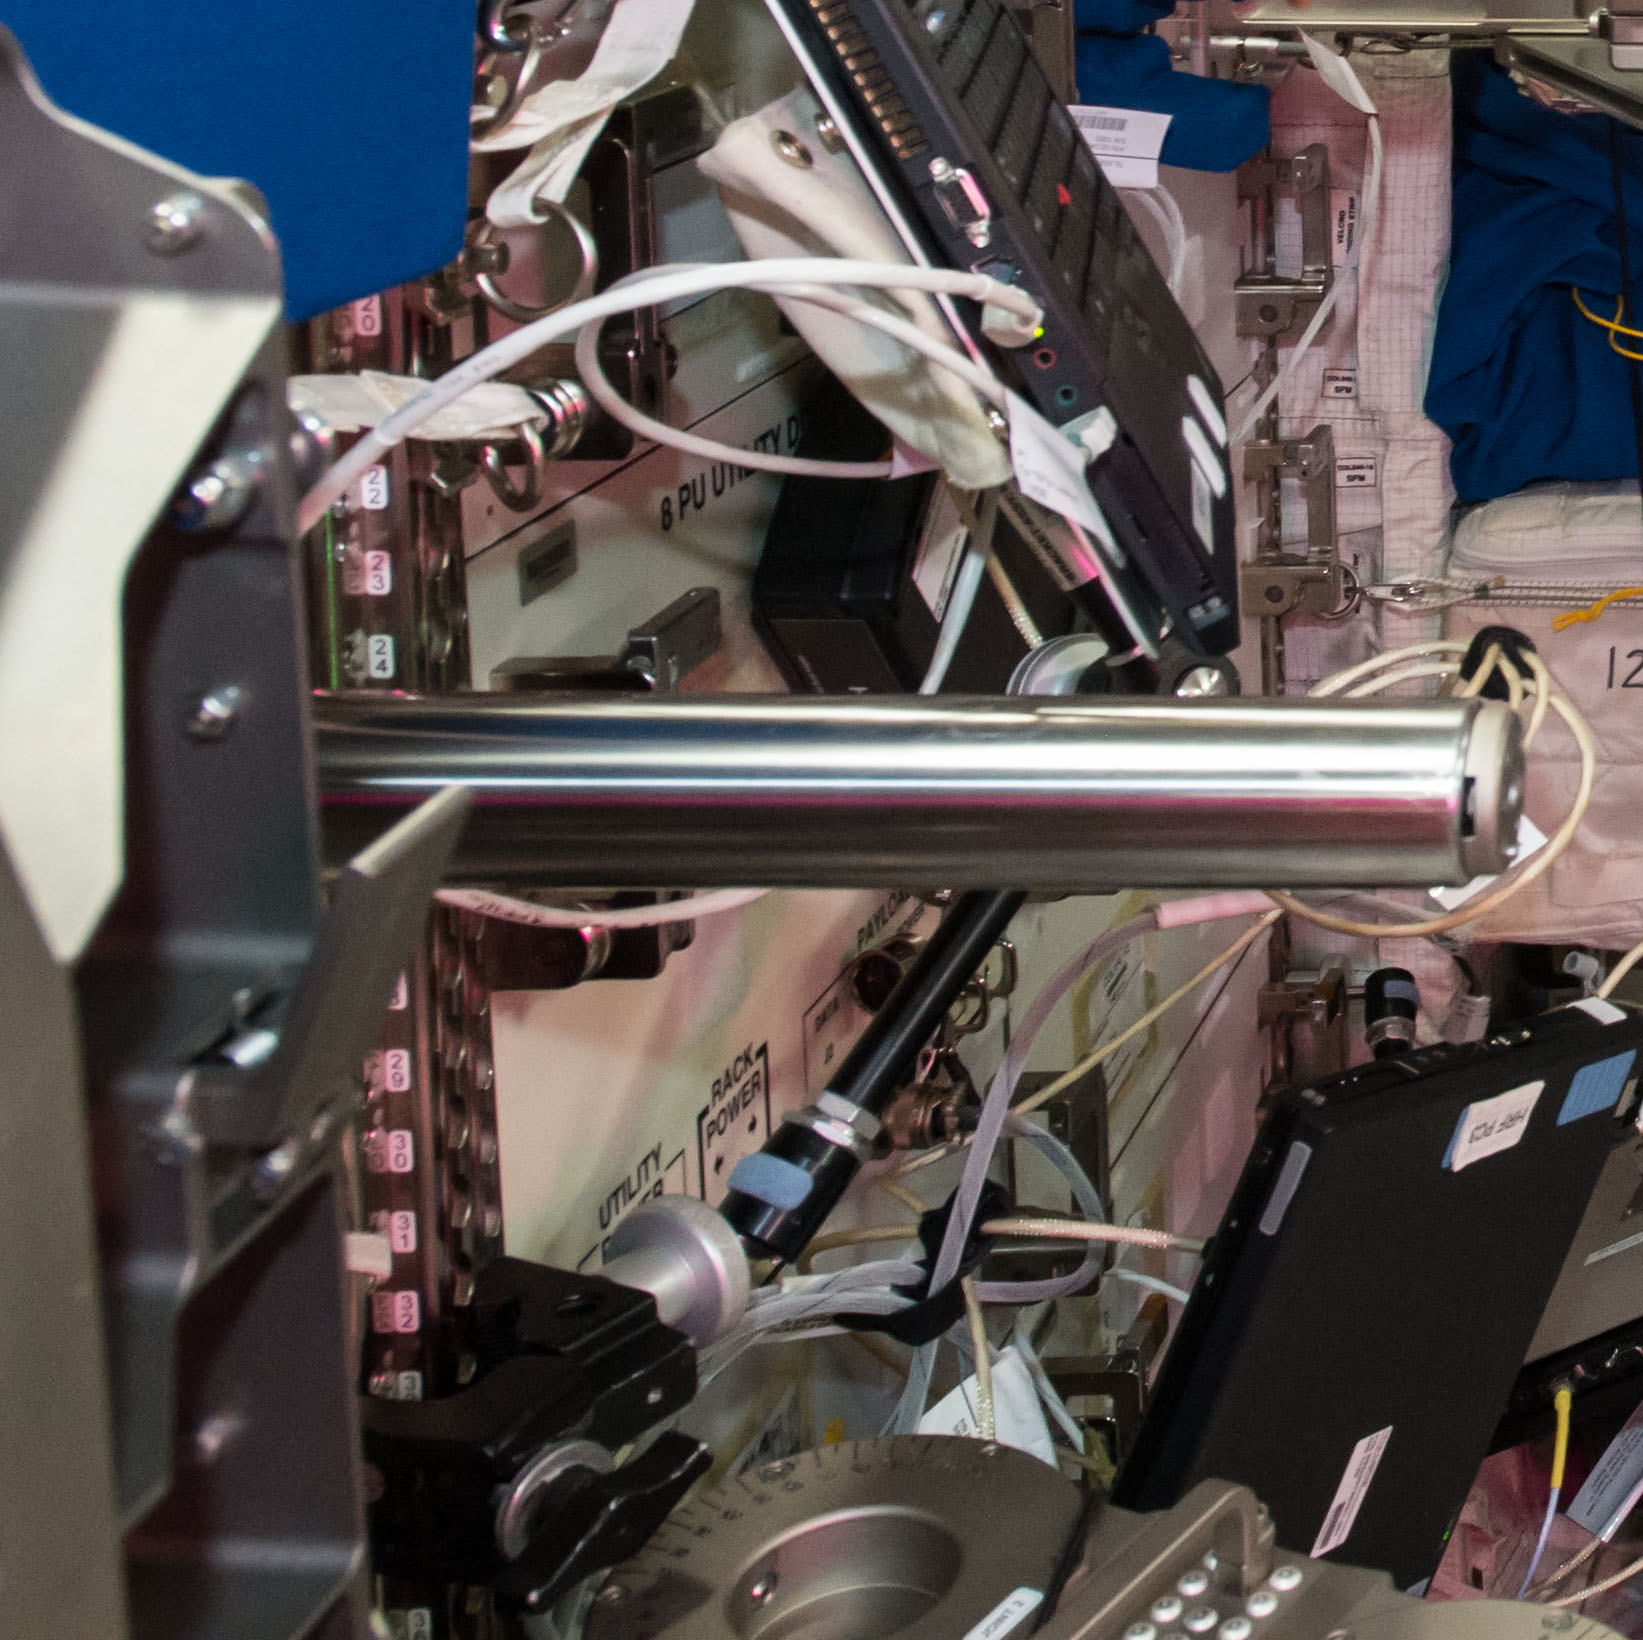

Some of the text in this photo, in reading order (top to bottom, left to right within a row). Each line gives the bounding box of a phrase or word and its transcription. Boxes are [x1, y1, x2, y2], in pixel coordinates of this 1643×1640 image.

[661, 496, 674, 530] 8
[679, 476, 706, 521] PU
[374, 639, 388, 673] 24
[711, 1042, 753, 1104] RACK
[706, 1070, 761, 1149] POWER
[601, 1142, 661, 1230] UTILITY
